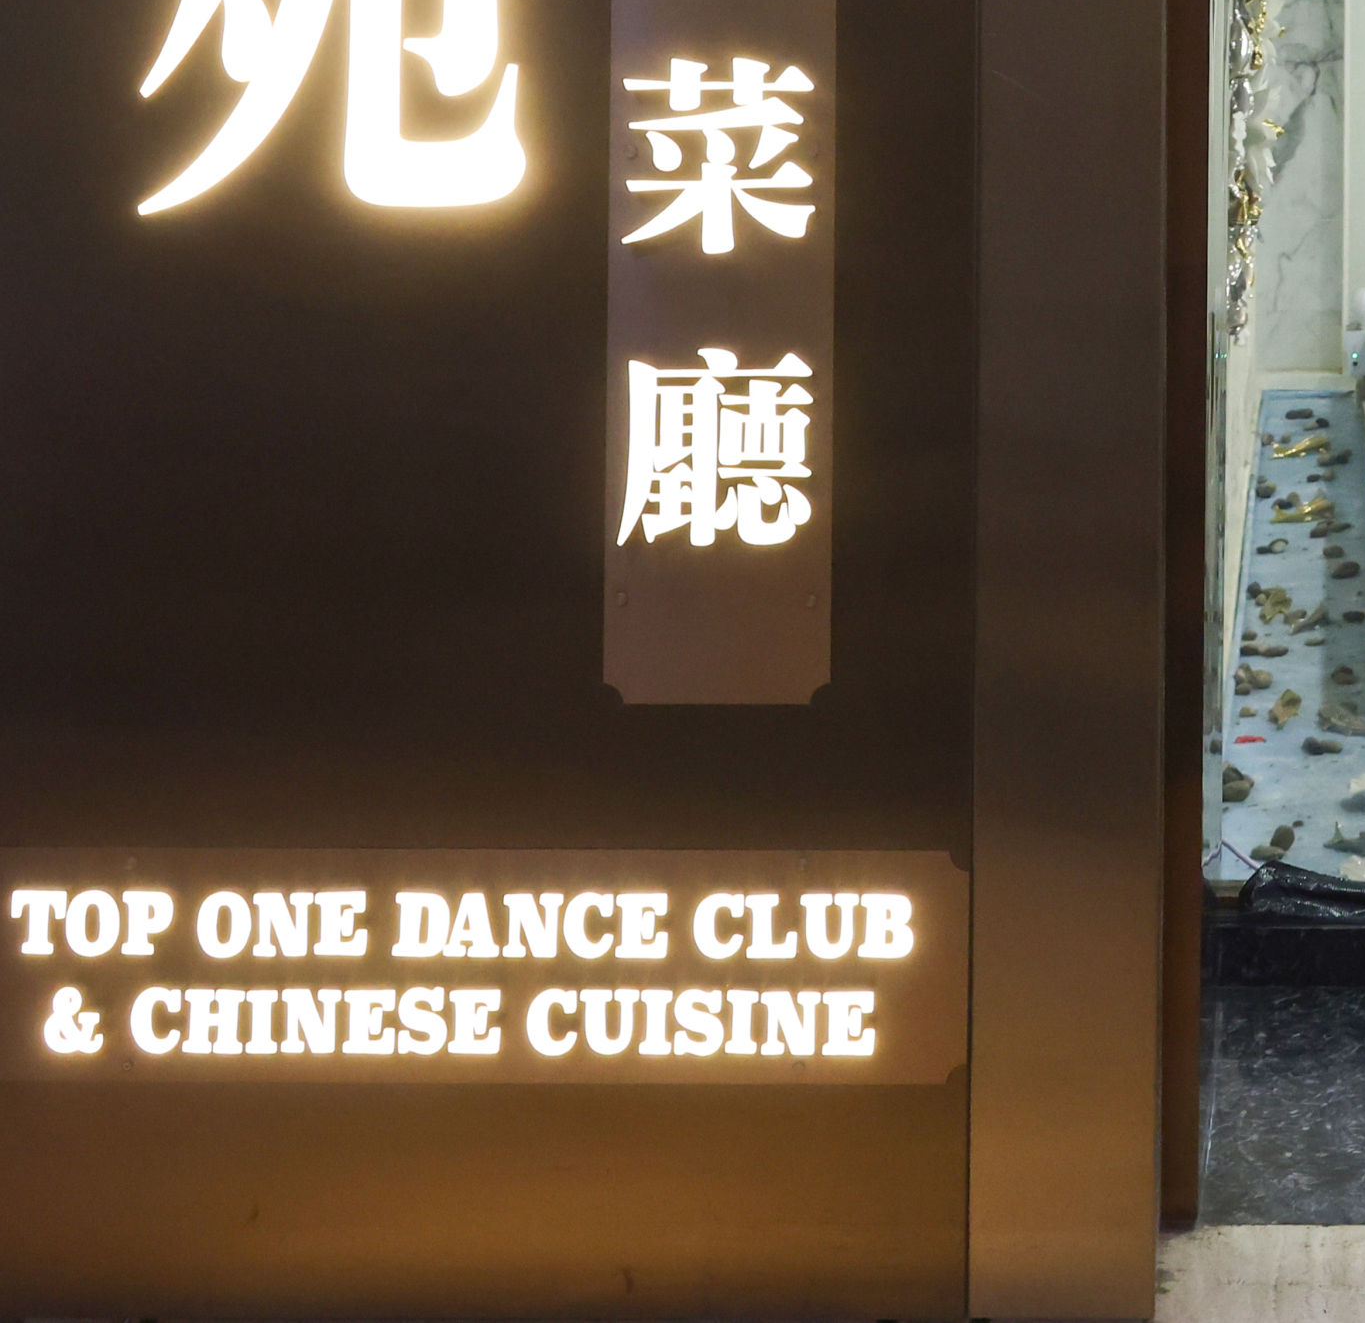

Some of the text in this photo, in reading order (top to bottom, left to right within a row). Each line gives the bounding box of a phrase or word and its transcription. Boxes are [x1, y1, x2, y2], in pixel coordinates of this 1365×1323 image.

[10, 889, 914, 960] TOP ONE DANCE CLUB
[43, 986, 876, 1057] & CHINESE CUISINE
